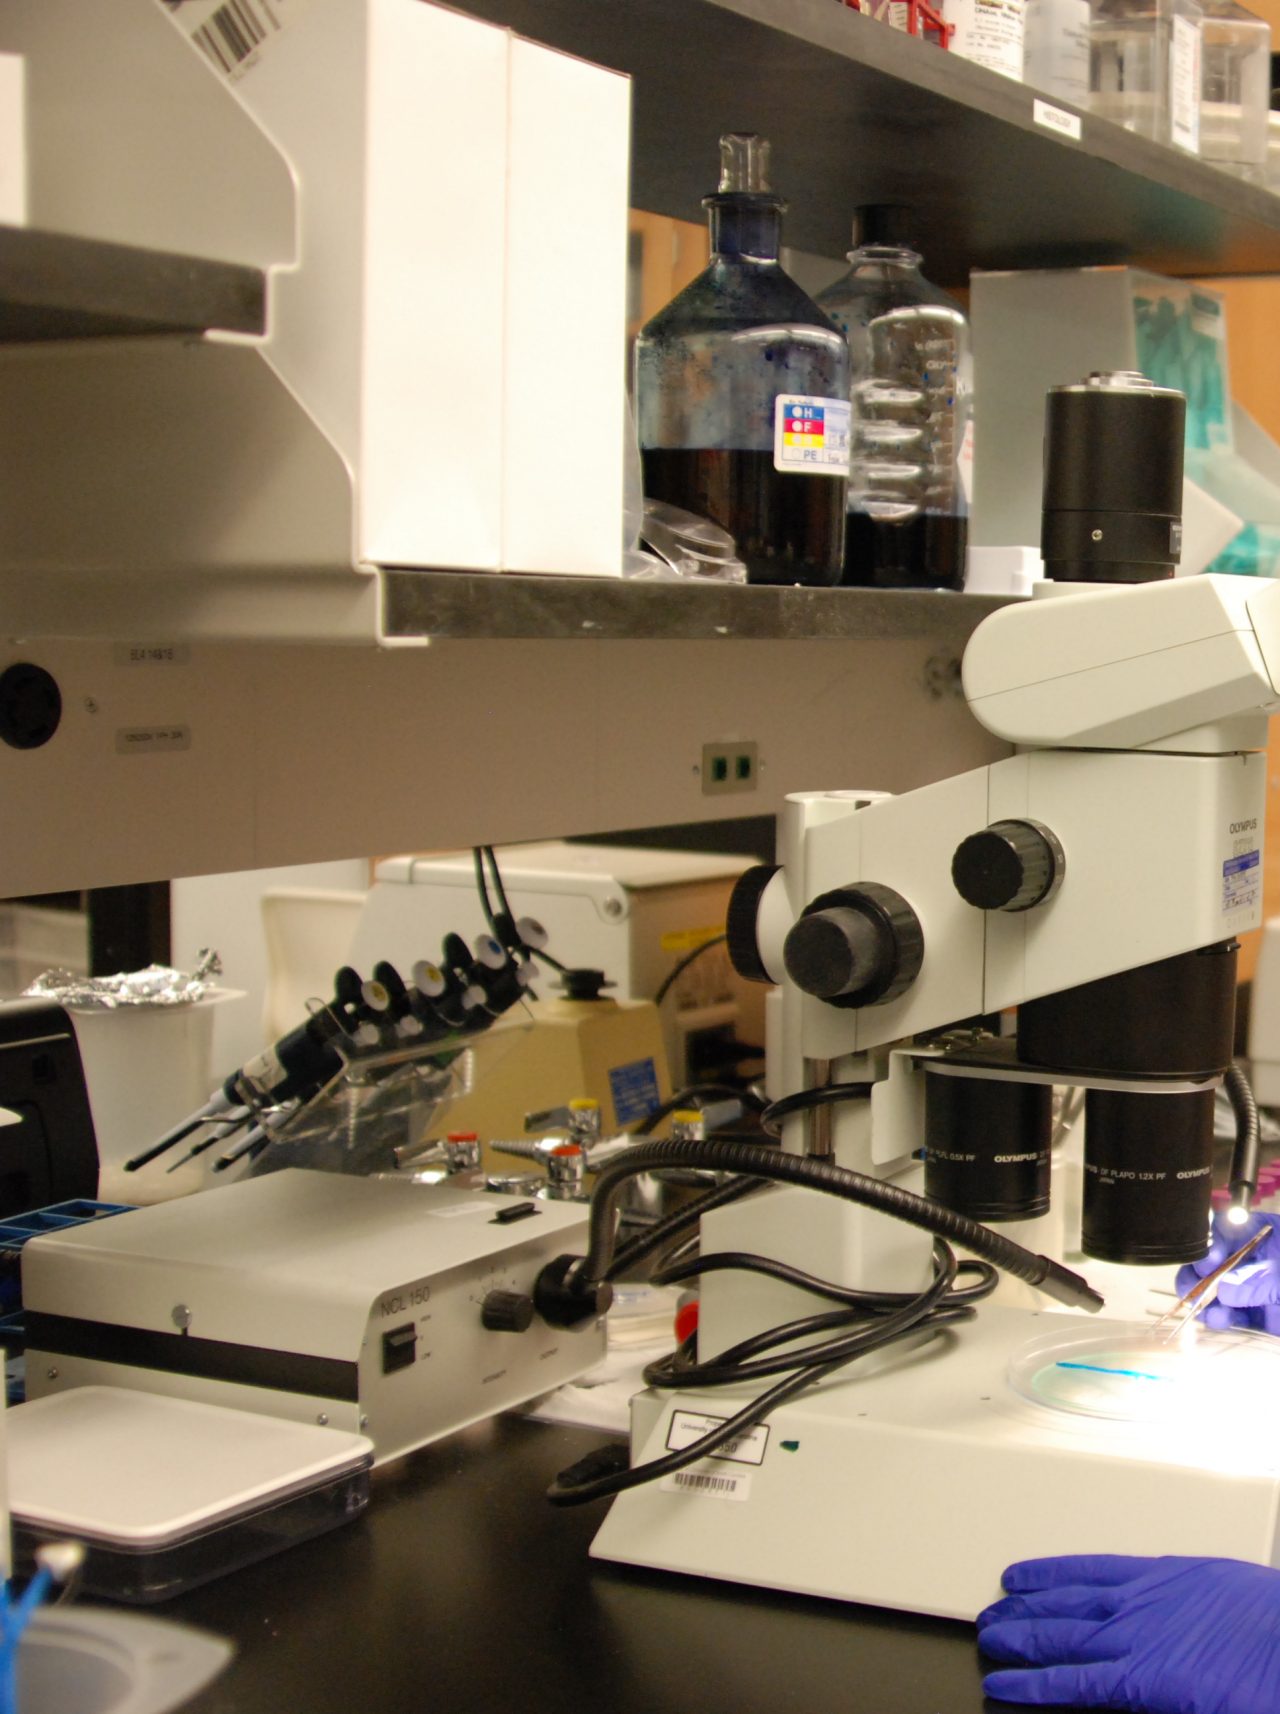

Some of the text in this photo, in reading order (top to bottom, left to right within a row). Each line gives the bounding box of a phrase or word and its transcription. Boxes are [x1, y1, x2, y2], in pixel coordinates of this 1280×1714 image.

[803, 407, 813, 419] H
[803, 421, 812, 433] F
[803, 449, 817, 460] PE
[1229, 819, 1257, 834] OLYMPUS
[993, 1152, 1038, 1164] OLYMPUS
[1110, 1169, 1136, 1180] PLAPO
[1156, 1172, 1167, 1180] PF
[1176, 1166, 1211, 1180] OLYMPUS
[380, 1285, 431, 1319] NCL 150
